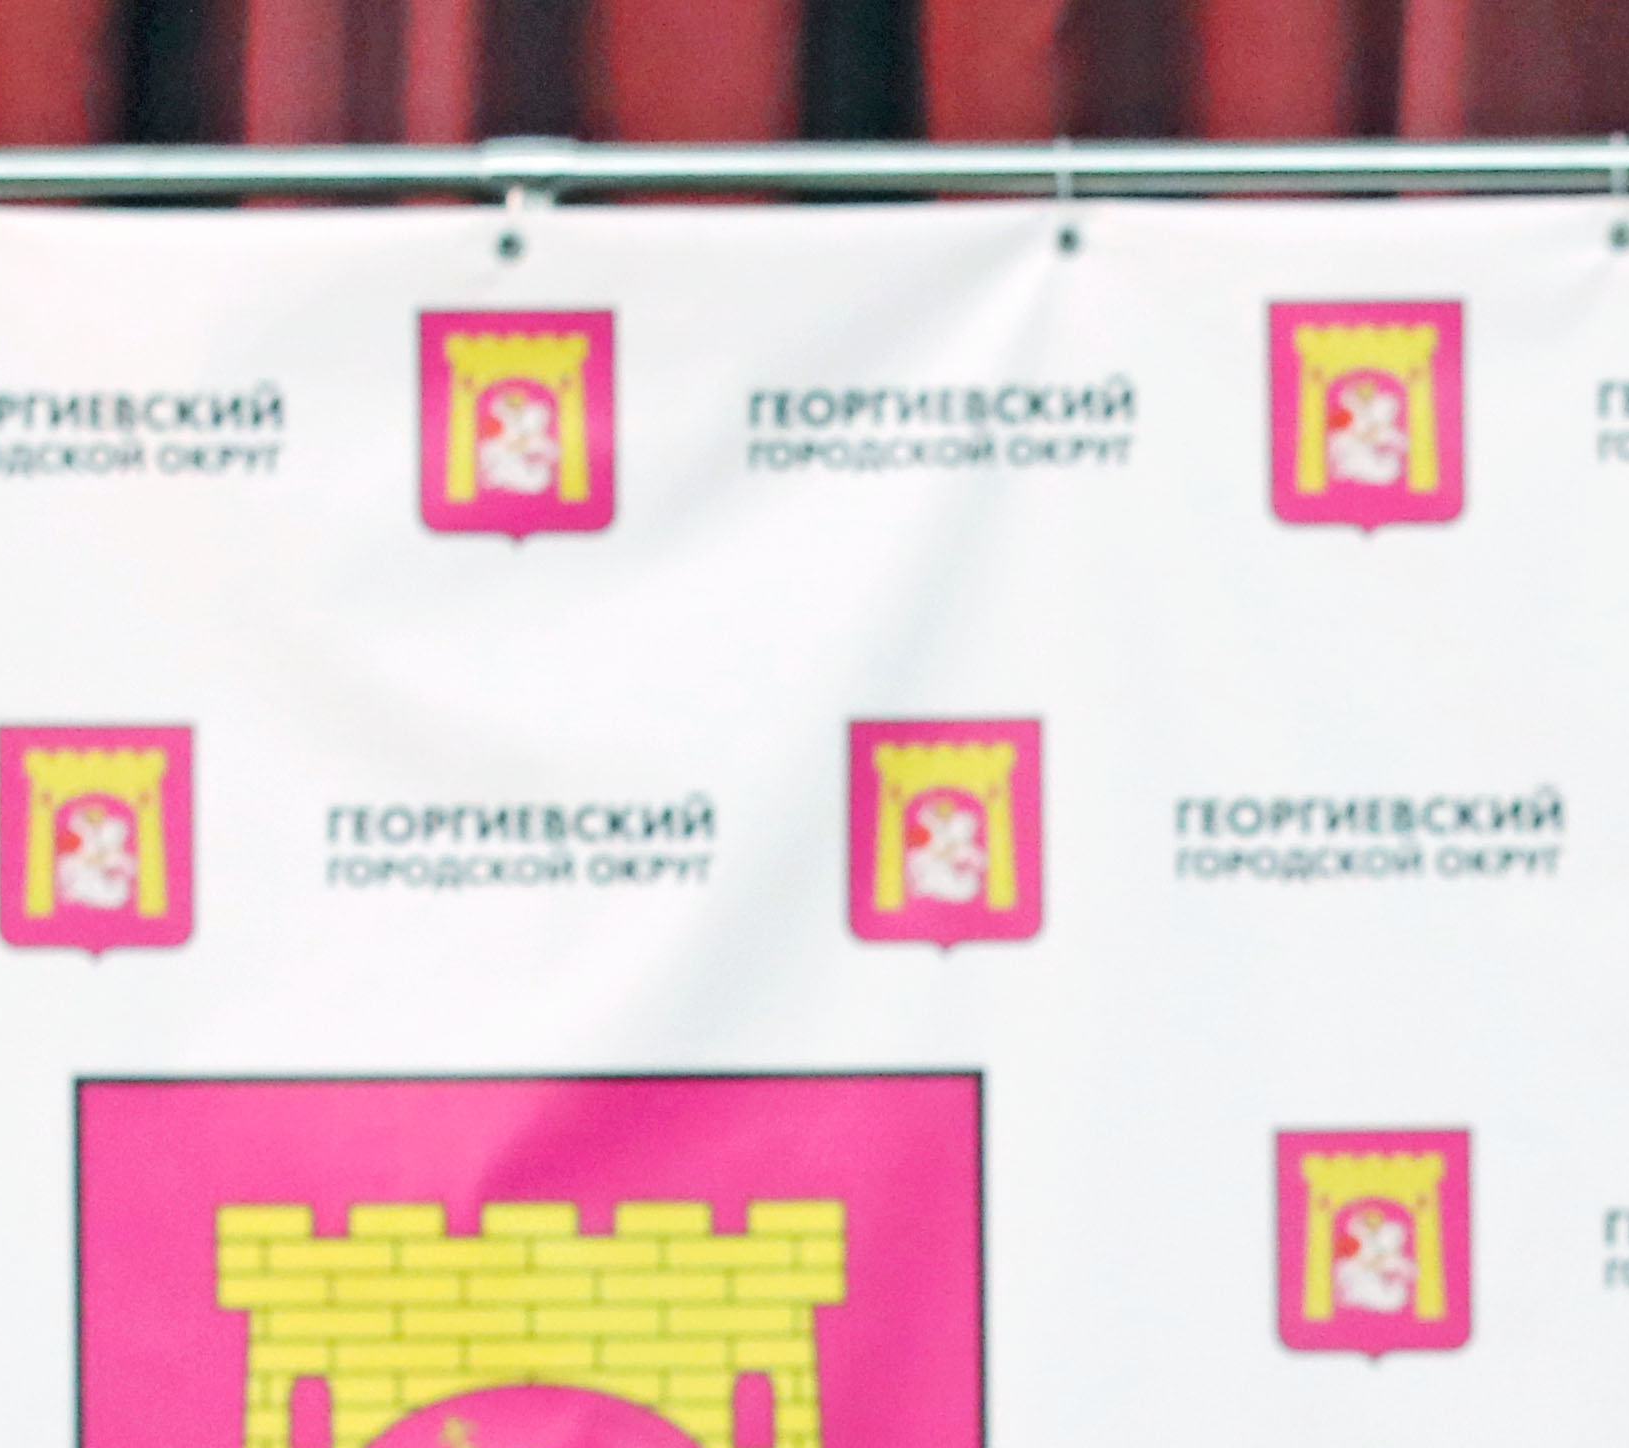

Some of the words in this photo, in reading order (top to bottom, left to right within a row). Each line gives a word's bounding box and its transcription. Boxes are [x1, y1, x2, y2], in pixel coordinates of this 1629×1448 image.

[748, 376, 1136, 427] ГЕОРГИЕВСКИЙ
[157, 444, 279, 473] ОКРУГ
[748, 434, 996, 470] ГОРОДСКОЙ
[1007, 436, 1131, 466] ОКРУГ
[327, 794, 716, 845] ГЕОРГИЕВСКИЙ
[1176, 786, 1564, 837] ГЕОРГИЕВСКИЙ
[327, 852, 575, 888] ГОРОДСКОЙ
[588, 855, 710, 885] ОКРУГ
[1176, 846, 1424, 880] ГОРОДСКОЙ
[1436, 846, 1559, 877] ОКРУГ
